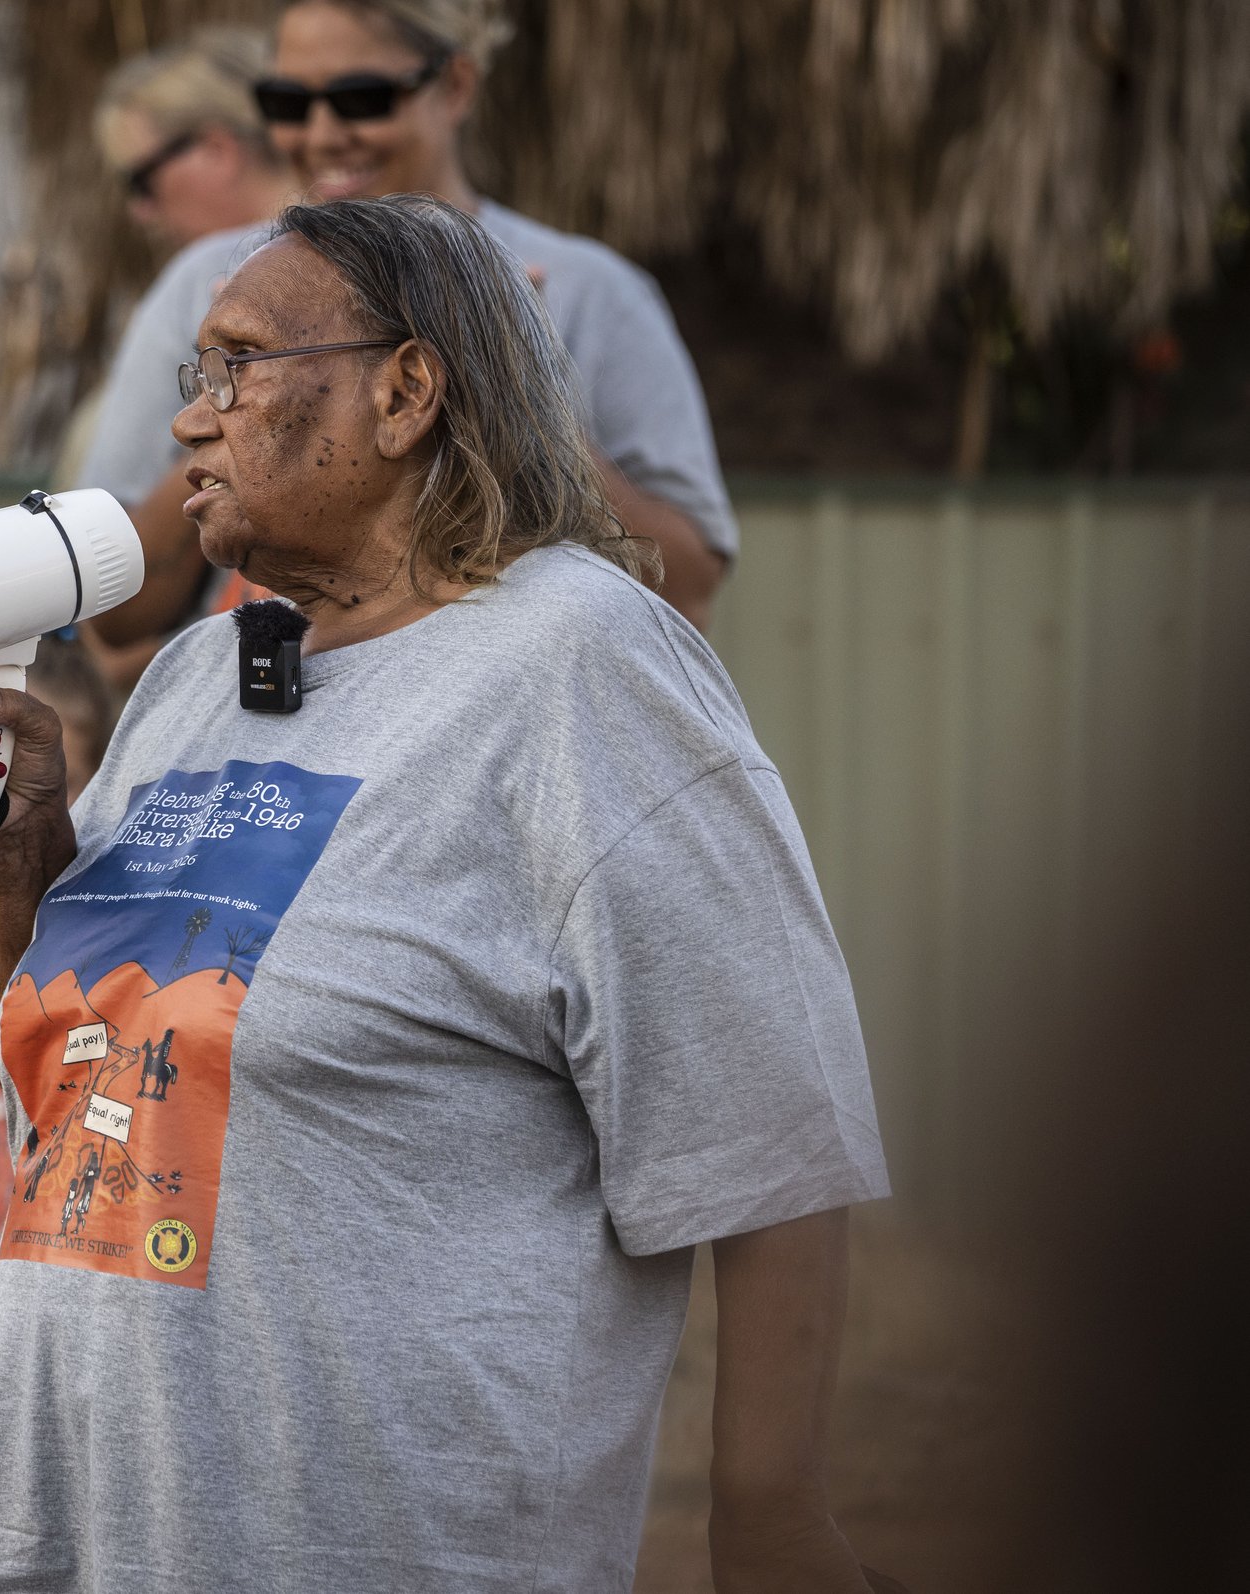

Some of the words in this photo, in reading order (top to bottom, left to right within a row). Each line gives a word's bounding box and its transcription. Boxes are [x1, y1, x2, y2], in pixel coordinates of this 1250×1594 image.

[252, 657, 272, 668] RØDE
[229, 790, 246, 800] the
[246, 781, 291, 809] 80th
[213, 810, 228, 819] of
[226, 810, 241, 819] the
[240, 802, 304, 830] 1946
[124, 860, 143, 872] 1st
[142, 861, 169, 875] May
[167, 854, 199, 870] 2026
[94, 893, 108, 901] our
[105, 892, 129, 903] people
[163, 889, 182, 898] hard
[180, 889, 193, 899] for
[192, 892, 208, 901] our
[209, 895, 231, 905] work
[66, 1037, 81, 1053] qual
